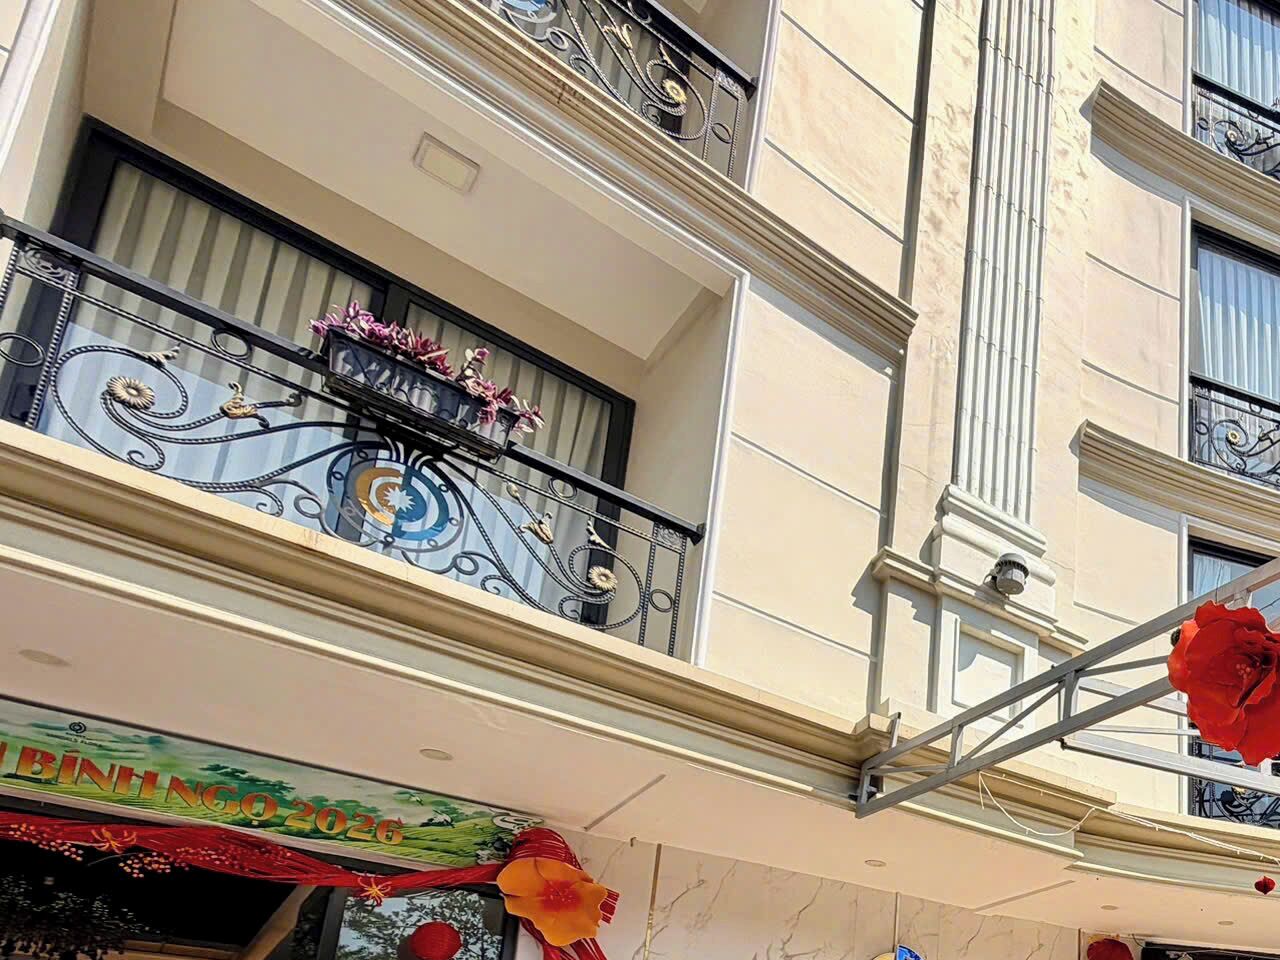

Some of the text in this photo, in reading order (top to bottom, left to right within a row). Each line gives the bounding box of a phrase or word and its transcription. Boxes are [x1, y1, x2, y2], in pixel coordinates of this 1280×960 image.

[15, 745, 160, 801] BÍNH
[164, 774, 279, 827] NGỌ
[283, 798, 405, 846] 2026
